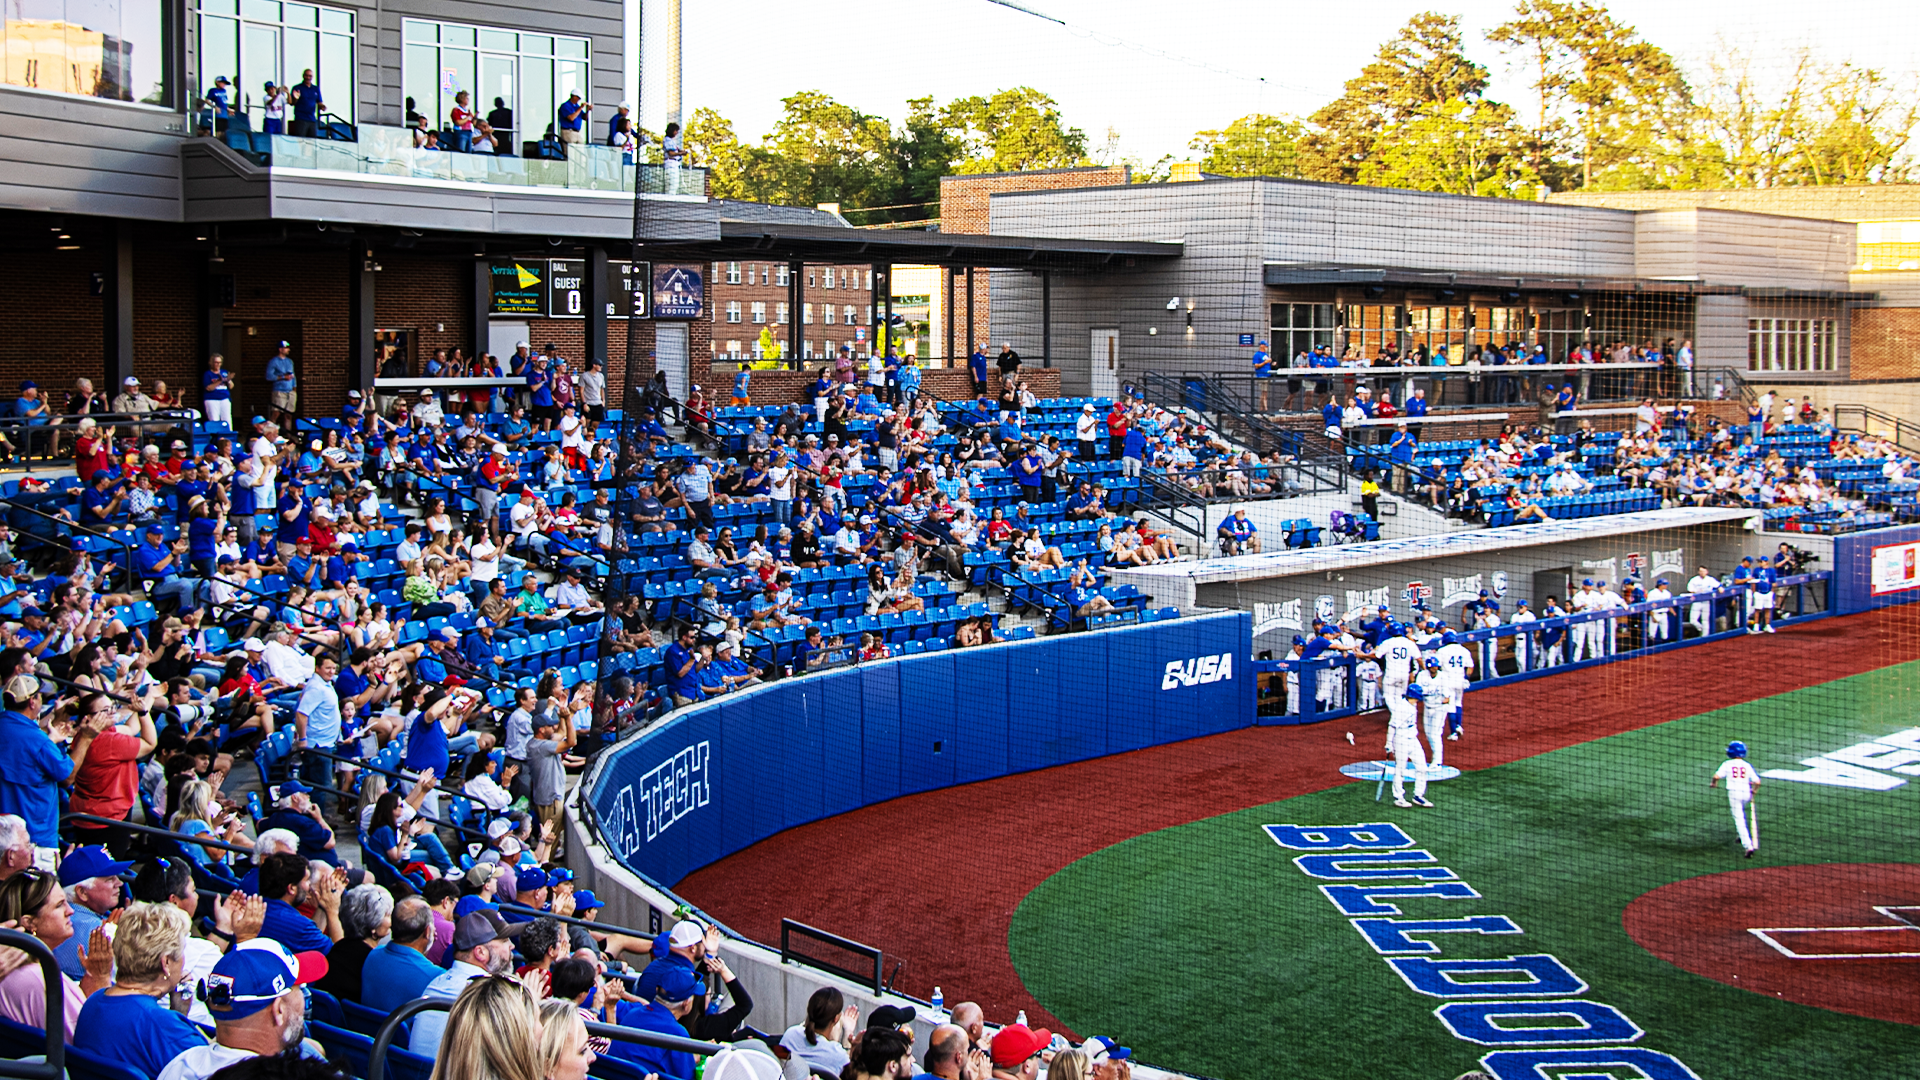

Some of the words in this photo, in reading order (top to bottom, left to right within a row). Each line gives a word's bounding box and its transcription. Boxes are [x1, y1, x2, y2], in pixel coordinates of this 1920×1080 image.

[553, 263, 568, 272] BALL
[555, 277, 581, 289] GUEST
[568, 290, 581, 314] 0
[634, 291, 645, 315] 3
[662, 294, 694, 305] NELA
[1393, 647, 1408, 659] 50
[1449, 656, 1463, 668] 44
[640, 740, 709, 842] TECH
